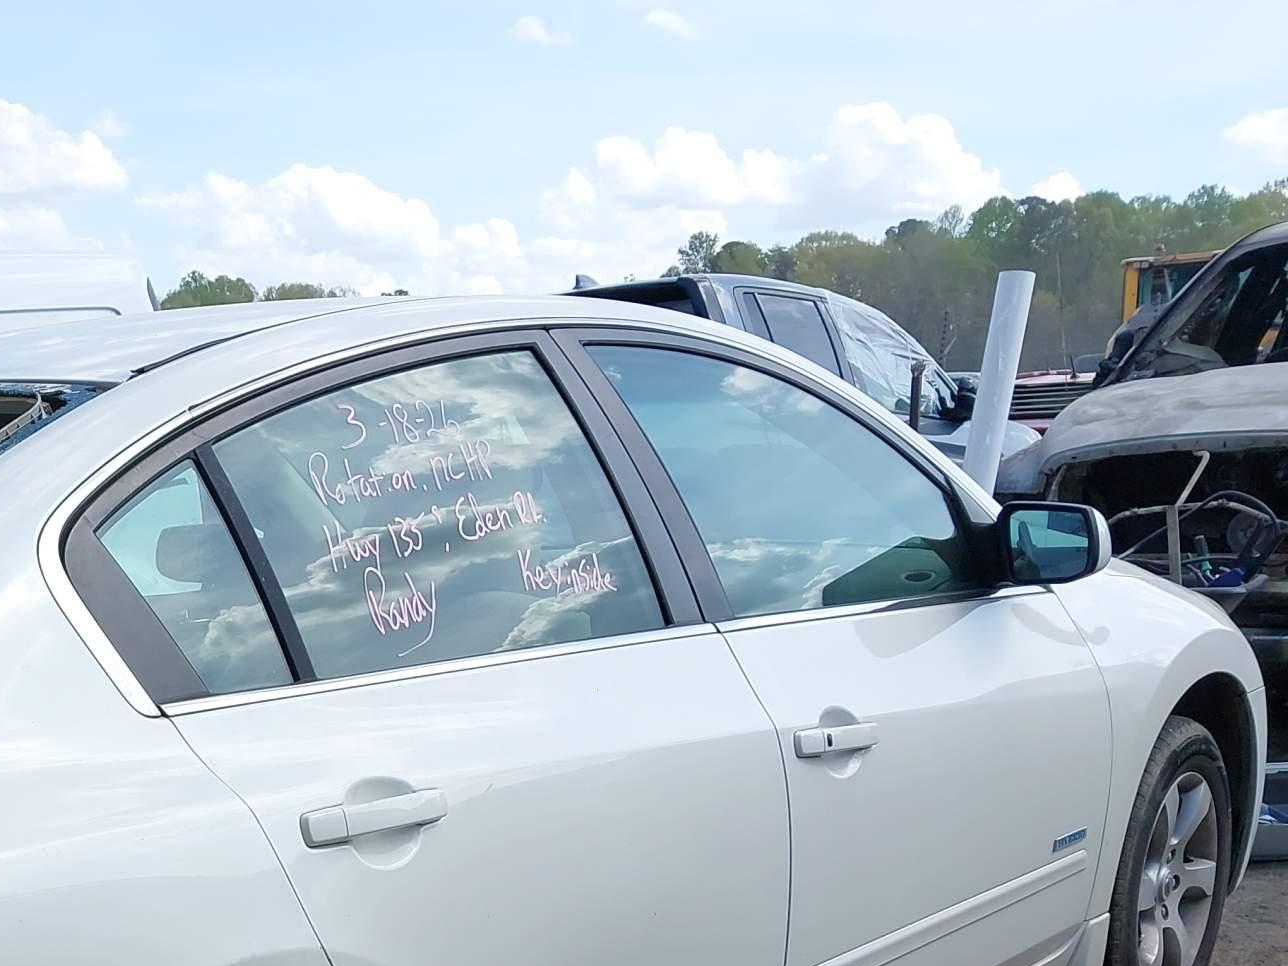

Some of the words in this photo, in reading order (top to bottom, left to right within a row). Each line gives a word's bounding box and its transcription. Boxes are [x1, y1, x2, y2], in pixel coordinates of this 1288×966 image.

[322, 519, 382, 573] Hwy
[455, 491, 514, 541] Eden
[363, 565, 437, 658] Randy
[517, 548, 562, 600] Key
